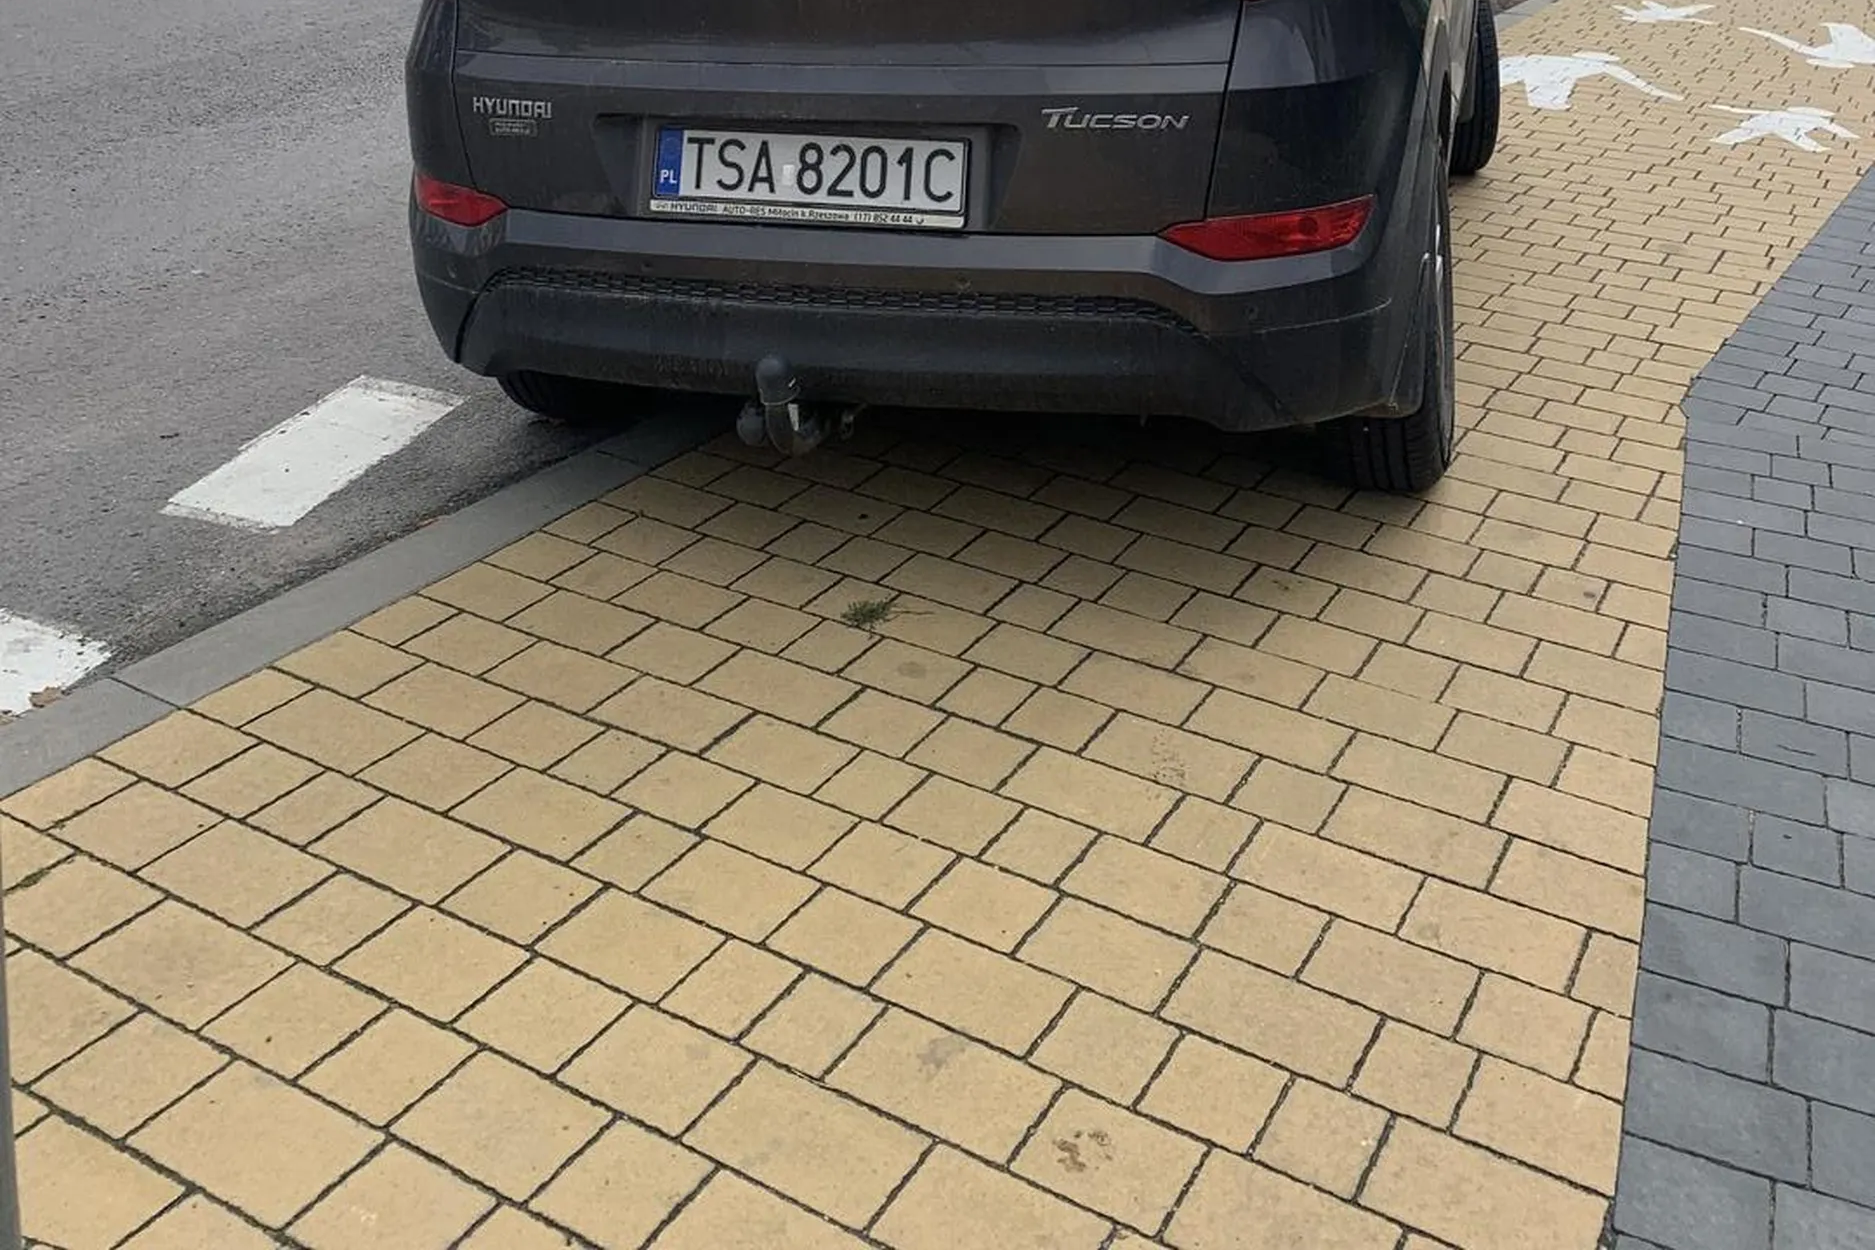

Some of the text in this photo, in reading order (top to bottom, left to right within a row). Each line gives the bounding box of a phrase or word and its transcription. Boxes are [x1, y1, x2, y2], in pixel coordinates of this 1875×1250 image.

[473, 96, 552, 119] HYUNDAI
[1041, 106, 1190, 129] TUCSON
[659, 169, 678, 185] PL
[687, 136, 957, 203] TSA 8201C
[670, 200, 718, 213] HYUNDAI
